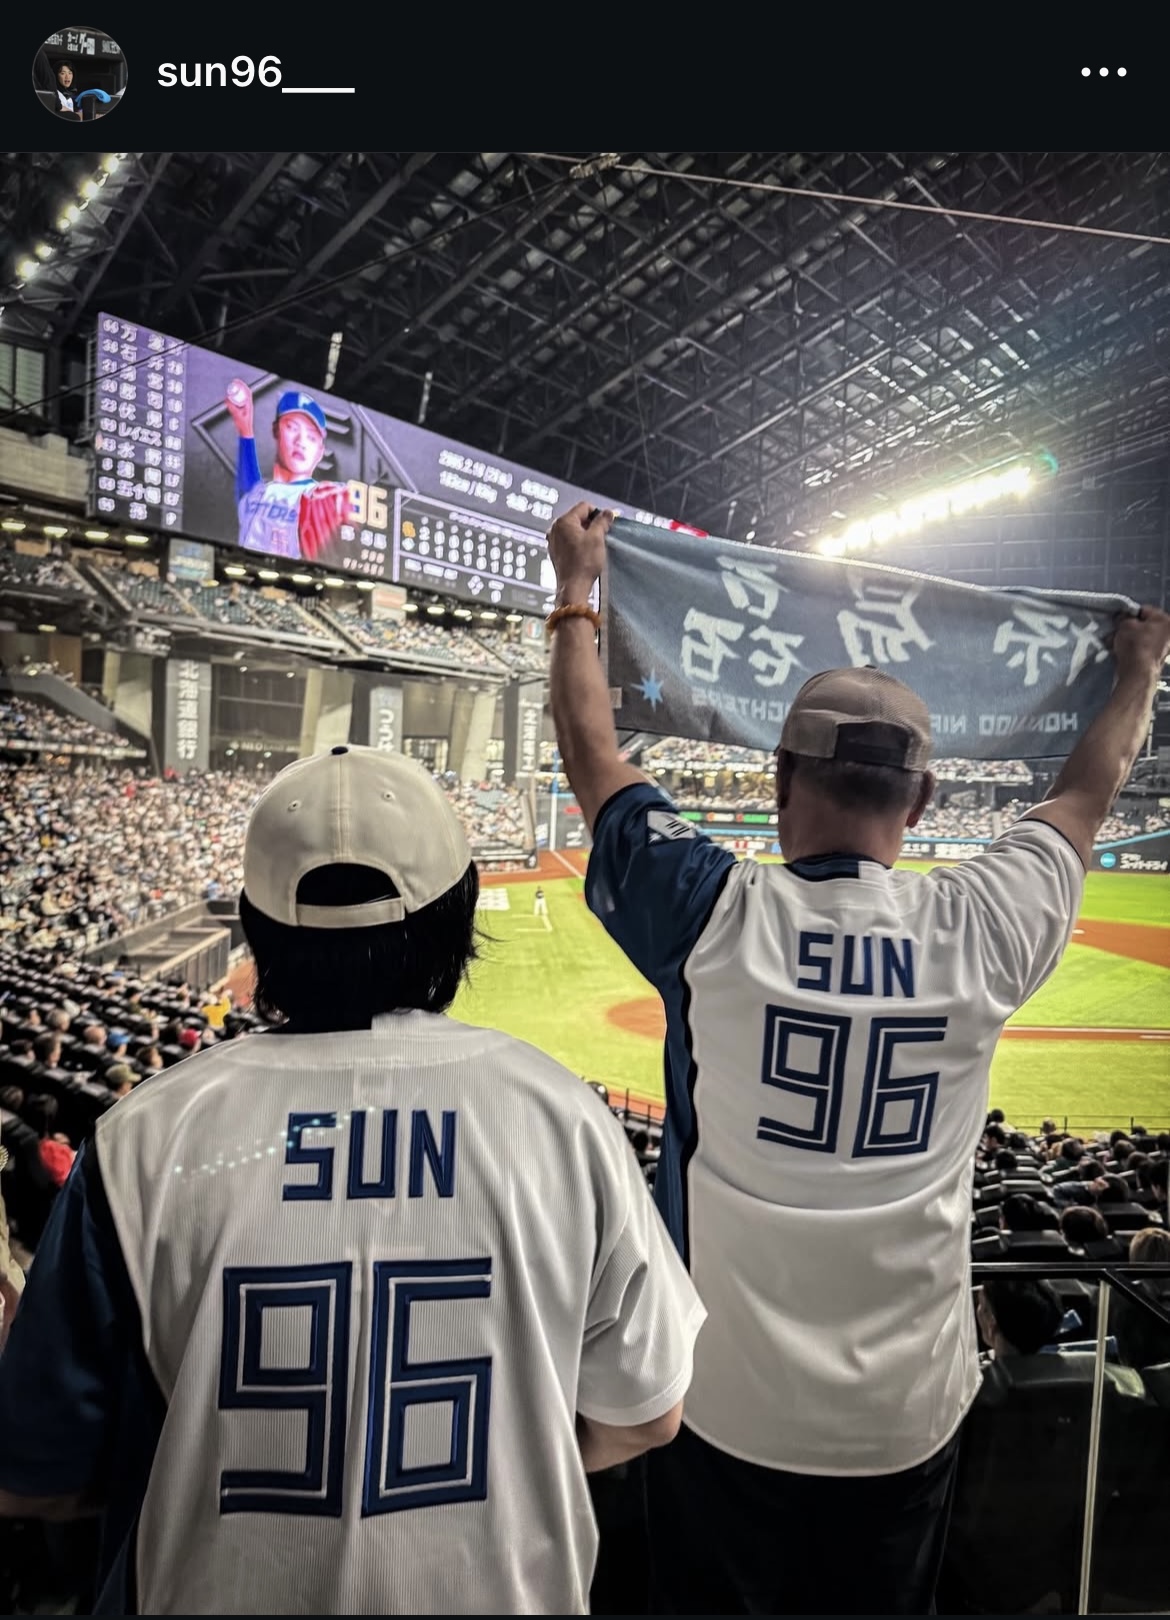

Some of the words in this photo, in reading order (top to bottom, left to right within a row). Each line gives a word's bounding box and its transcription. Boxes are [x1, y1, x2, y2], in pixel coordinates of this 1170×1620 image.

[348, 481, 388, 529] 96
[797, 931, 915, 998] SUN
[756, 1003, 948, 1158] 96
[282, 1109, 457, 1201] SUN
[218, 1256, 493, 1519] 96
